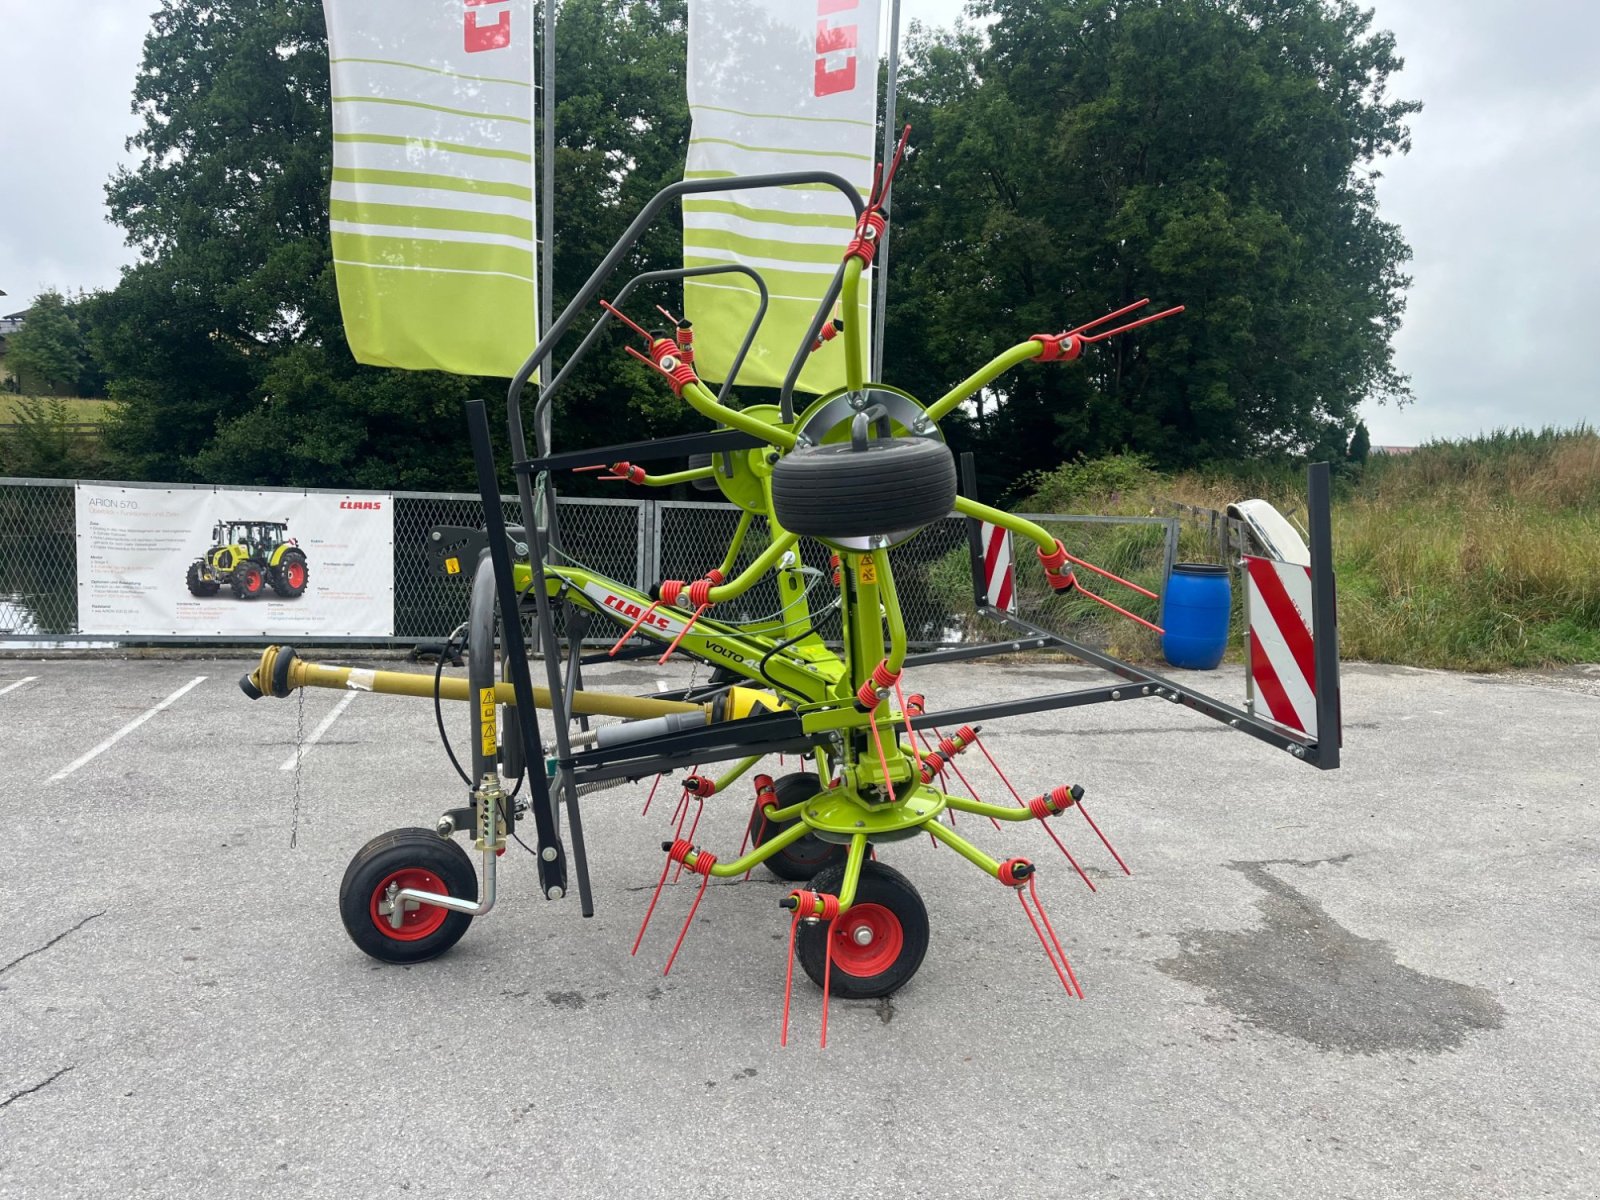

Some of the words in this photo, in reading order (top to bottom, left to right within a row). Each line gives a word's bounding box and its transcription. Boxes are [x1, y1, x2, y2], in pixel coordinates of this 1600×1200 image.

[88, 498, 118, 508] ARION
[120, 500, 138, 510] 570
[340, 501, 382, 510] CLAAS
[603, 595, 671, 632] CLAAS
[705, 640, 745, 664] VOLTO
